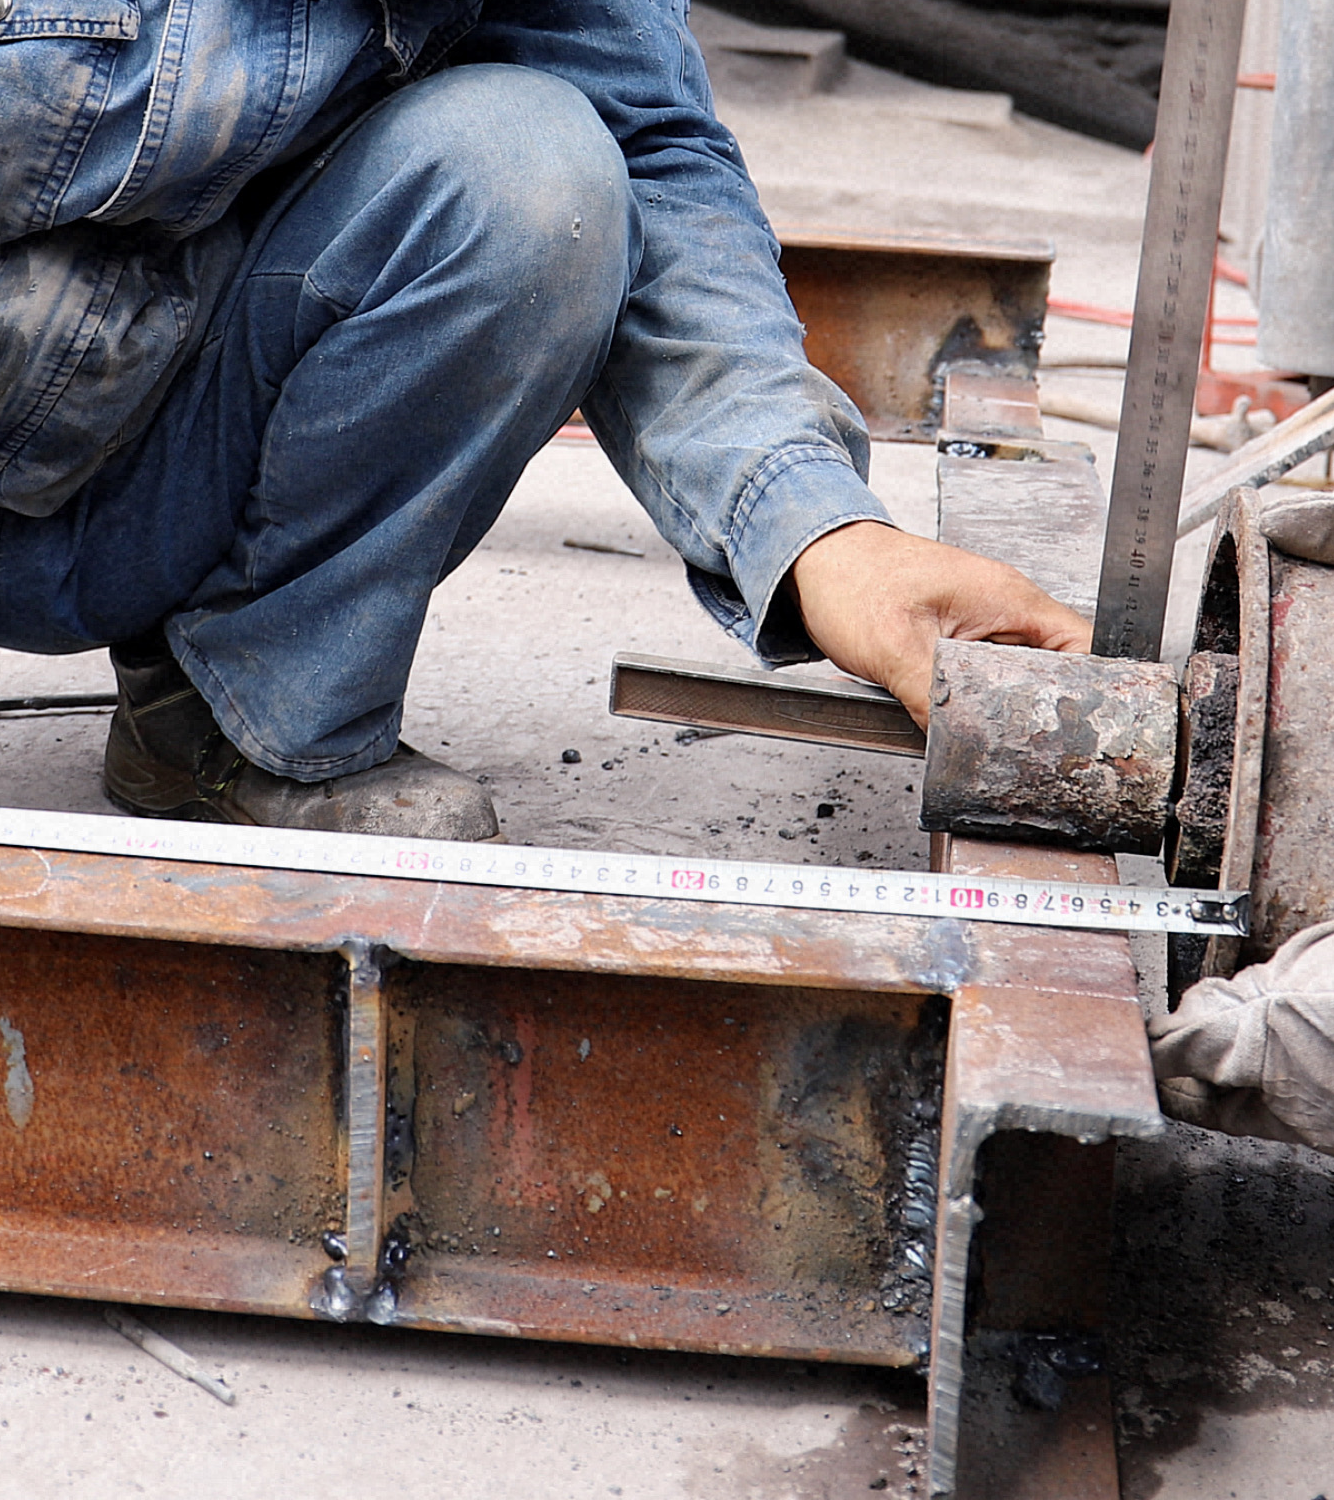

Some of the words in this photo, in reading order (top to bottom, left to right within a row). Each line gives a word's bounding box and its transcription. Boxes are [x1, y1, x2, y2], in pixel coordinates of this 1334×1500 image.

[1143, 461, 1156, 478] 36
[1140, 483, 1153, 500] 37
[1137, 506, 1150, 522] 38
[1135, 528, 1147, 544] 39
[1130, 548, 1147, 569] 40
[1128, 574, 1140, 588] 41
[1125, 596, 1138, 611] 42
[542, 864, 554, 877] 5
[570, 866, 582, 879] 4
[597, 867, 609, 881] 3
[624, 869, 637, 883] 2
[675, 871, 702, 889] 20
[708, 875, 720, 889] 9
[736, 876, 748, 891] 8
[764, 879, 775, 893] 7
[792, 880, 804, 895] 6
[820, 882, 831, 897] 5
[848, 883, 860, 898] 4
[876, 885, 888, 900] 3
[903, 887, 915, 902] 2
[954, 890, 981, 907] 10
[987, 892, 999, 907] 9
[1016, 894, 1028, 909] 8
[1043, 895, 1056, 911] 7
[1072, 896, 1084, 912] 6
[1100, 898, 1112, 914] 5
[1128, 899, 1141, 916] 4
[1156, 901, 1169, 918] 3
